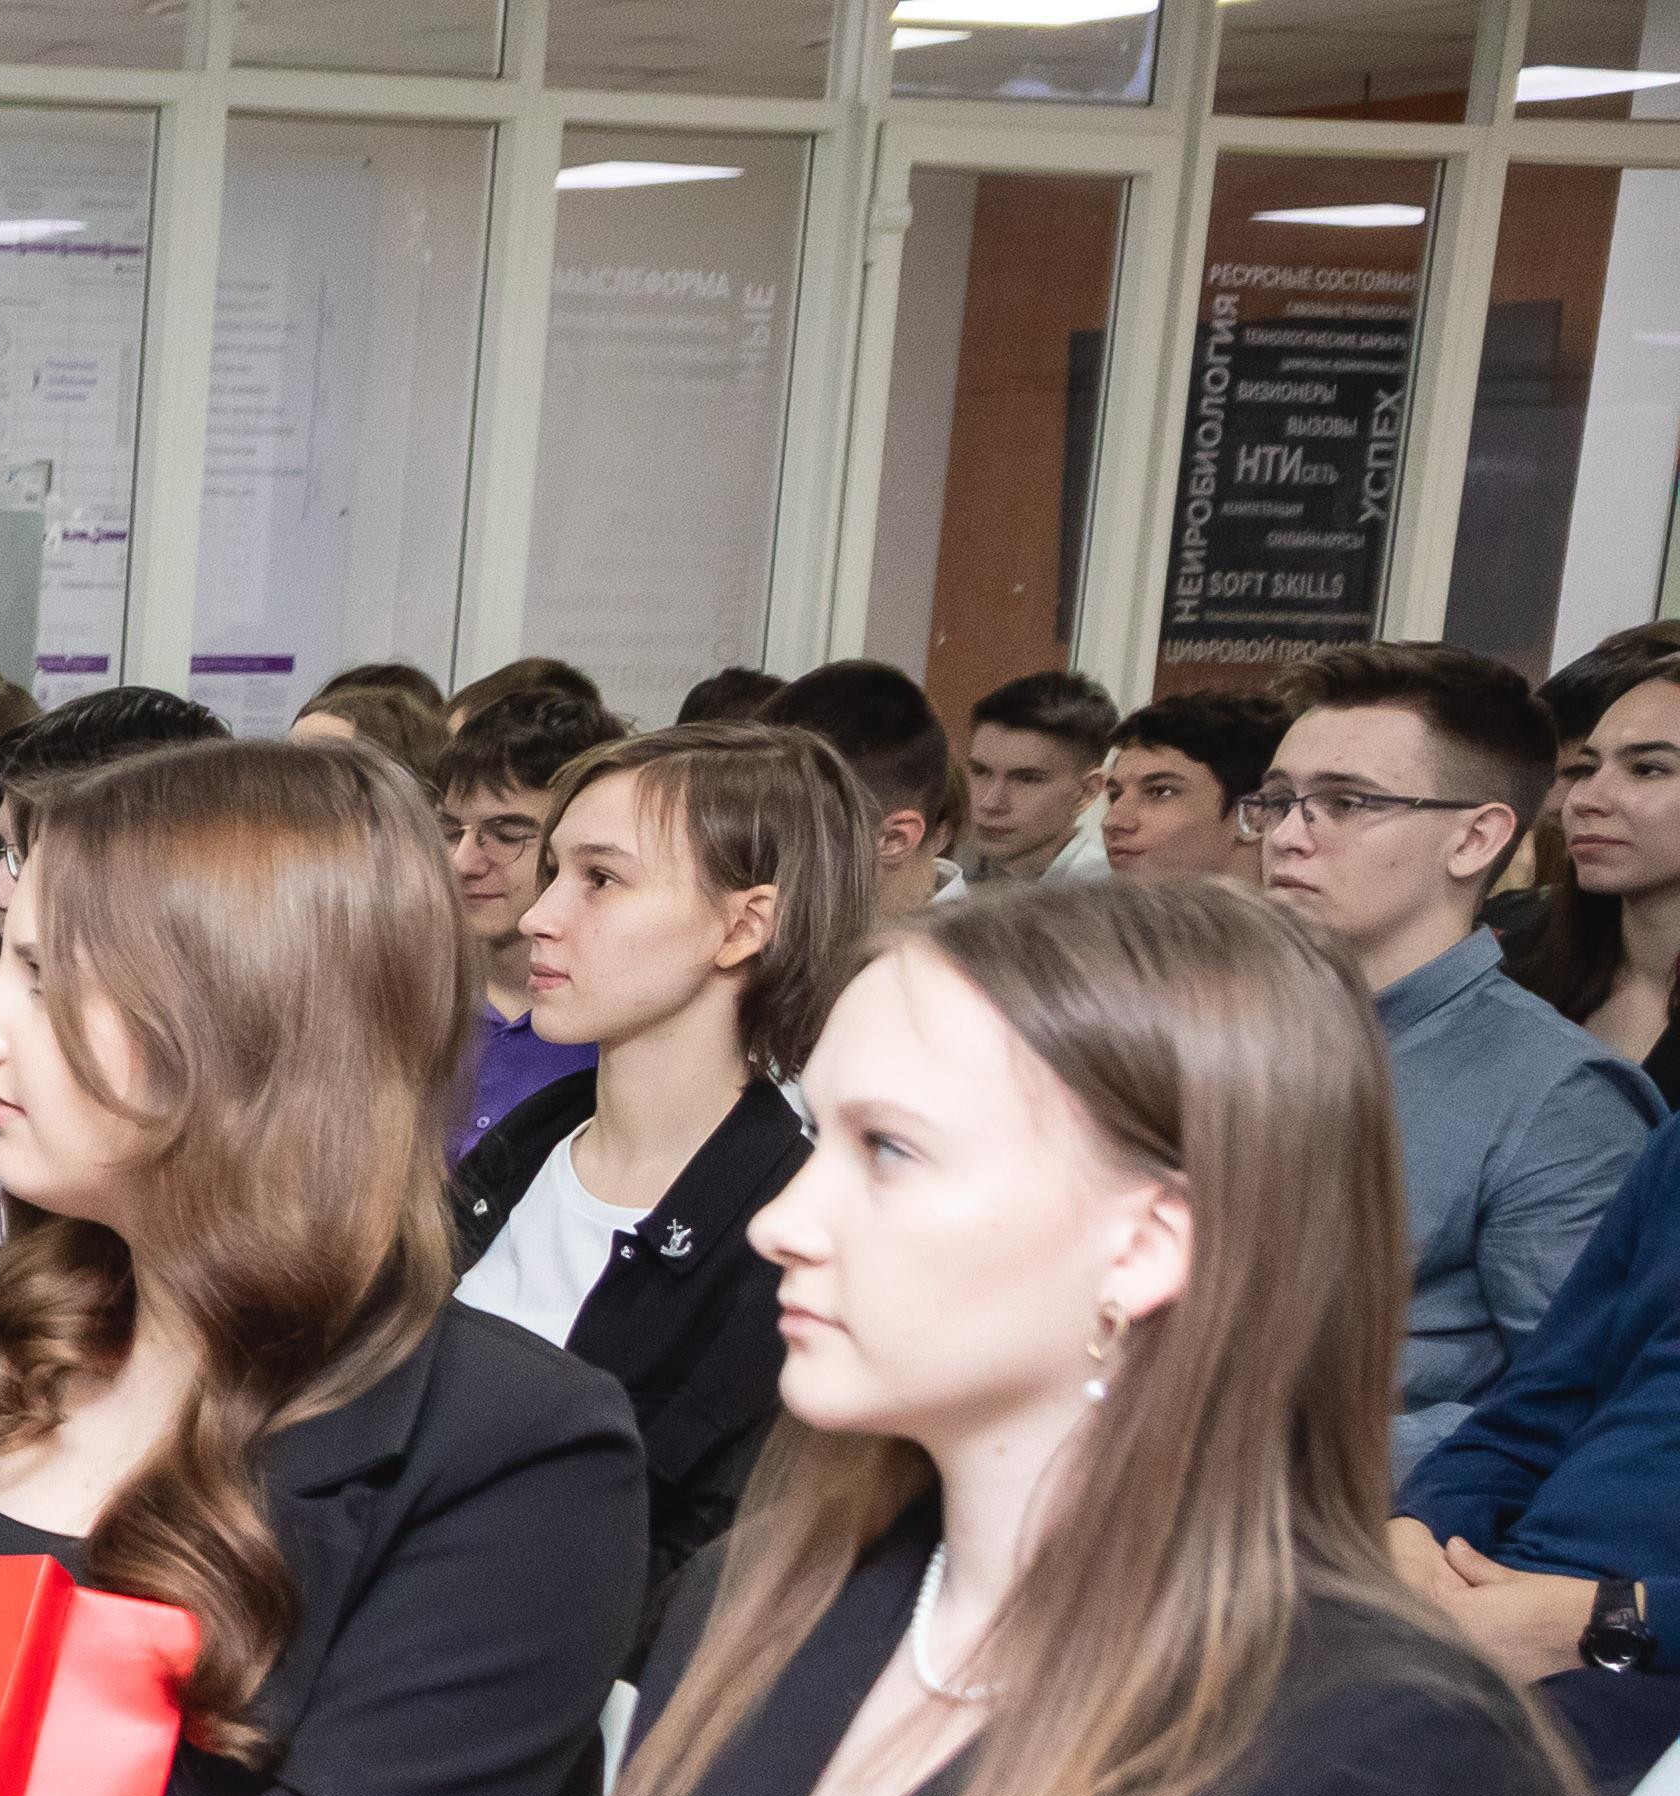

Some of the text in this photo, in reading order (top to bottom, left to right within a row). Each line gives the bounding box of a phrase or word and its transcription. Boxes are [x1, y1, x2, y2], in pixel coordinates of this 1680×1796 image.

[1210, 263, 1313, 290] РЕСУРСНЫЕ
[1237, 379, 1337, 403] ВИЗИОНЕРЫ
[1284, 415, 1358, 438] ВЫЗОВЫ
[1358, 388, 1406, 523] УСПЕХ
[1208, 570, 1346, 600] SOFT SKILLS
[1162, 634, 1278, 665] ЦИФРОВОЙ
